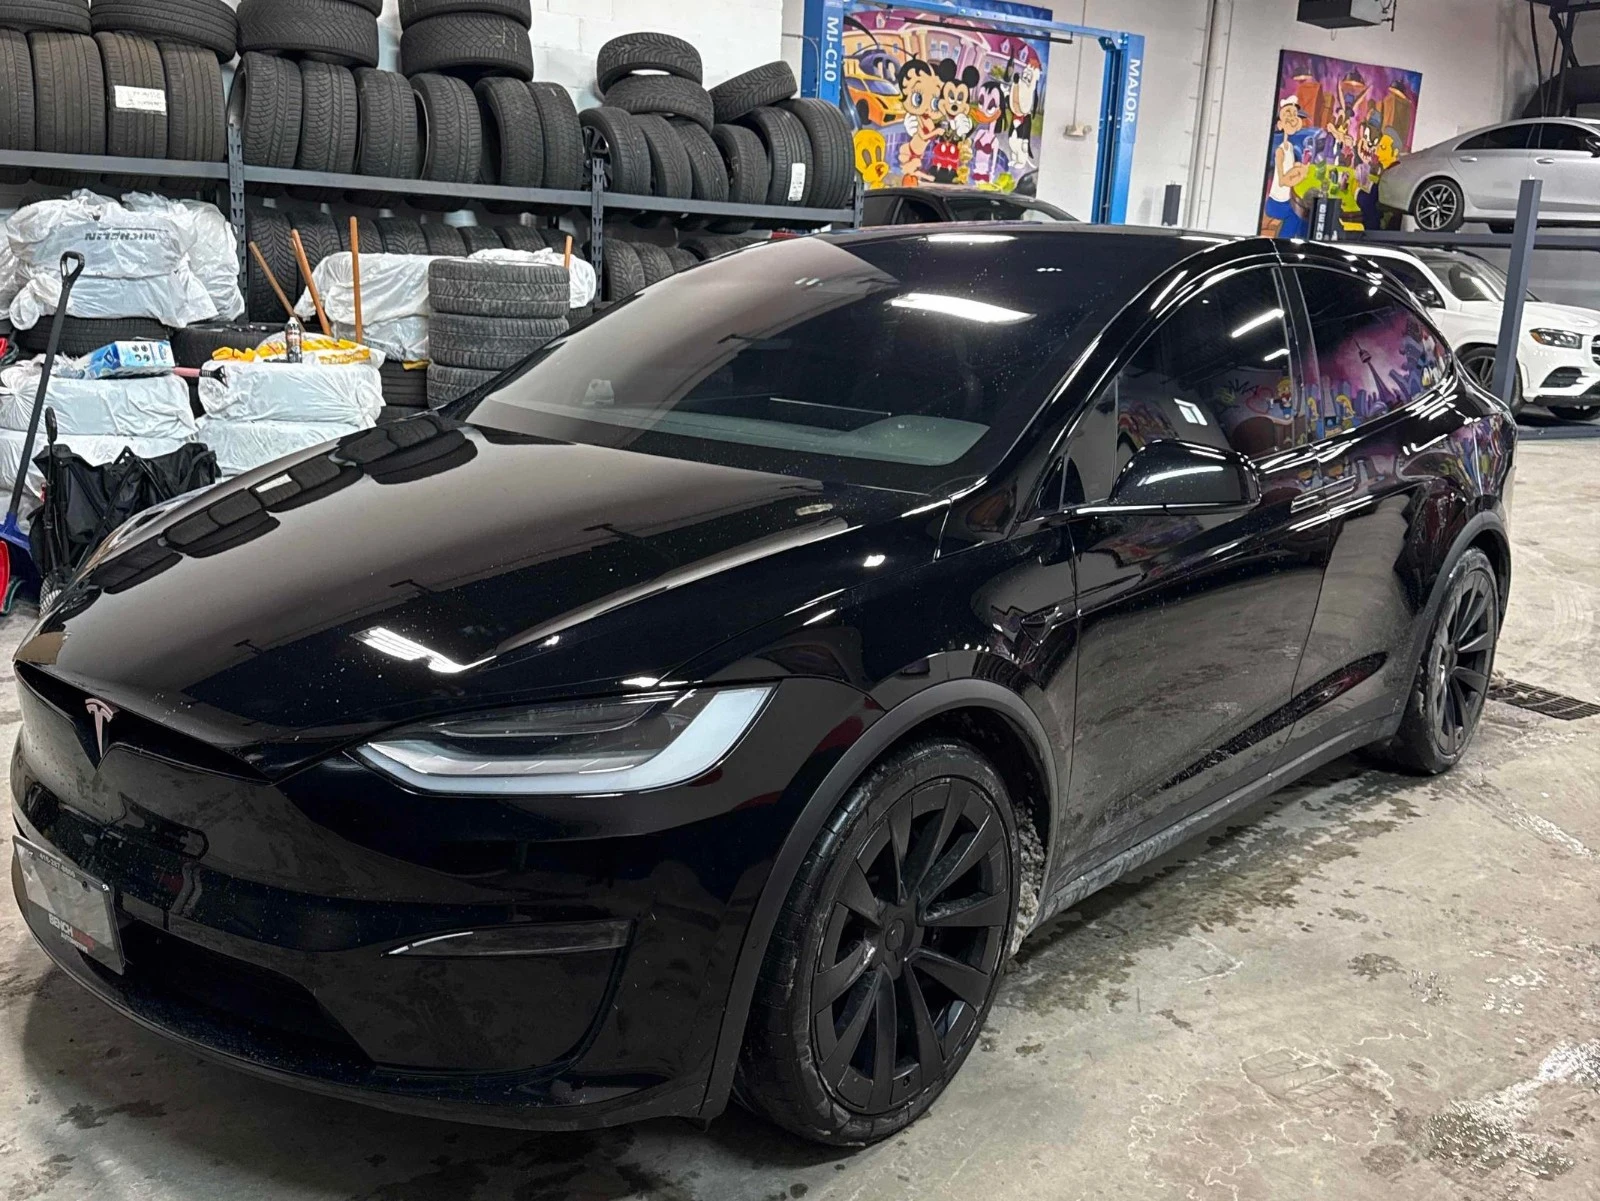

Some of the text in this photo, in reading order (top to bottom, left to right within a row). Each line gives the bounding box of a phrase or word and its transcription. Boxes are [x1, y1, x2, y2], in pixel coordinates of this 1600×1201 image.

[824, 16, 840, 82] MJ-C10
[1124, 58, 1141, 123] MAJOR
[84, 232, 155, 241] MICHELIN
